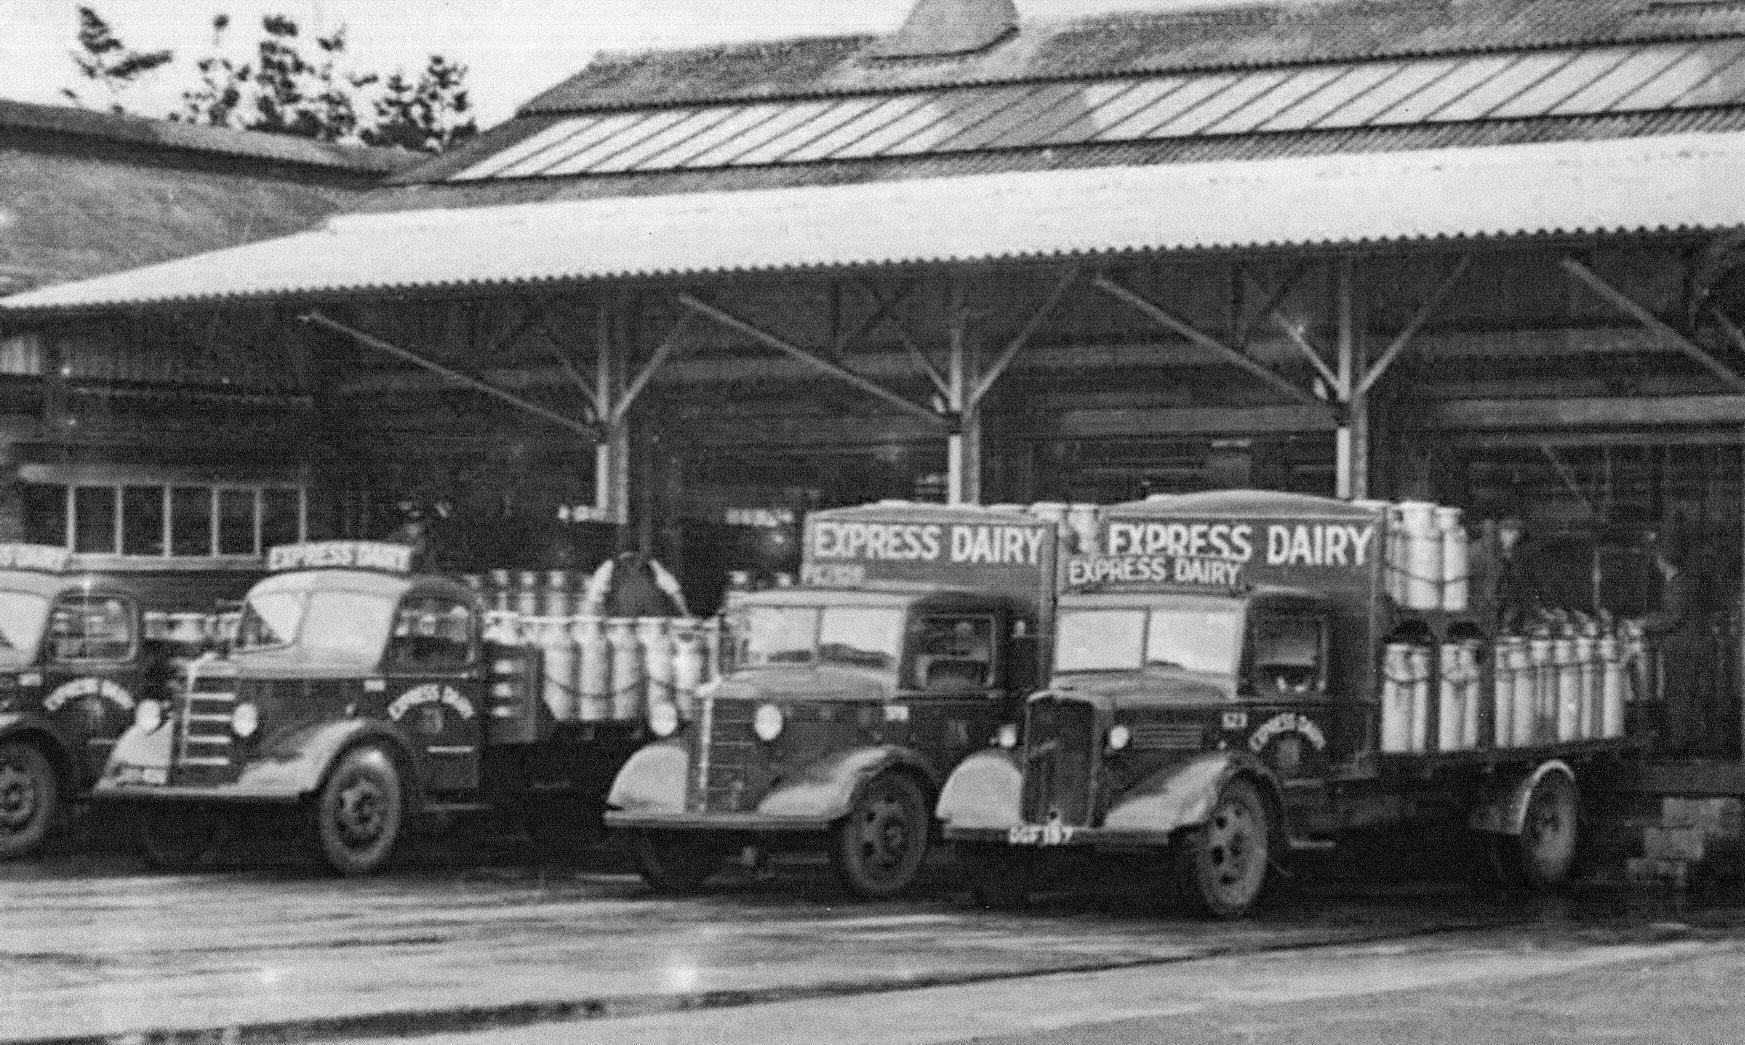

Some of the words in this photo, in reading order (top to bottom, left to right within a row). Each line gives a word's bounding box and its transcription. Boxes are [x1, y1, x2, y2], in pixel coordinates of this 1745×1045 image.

[814, 522, 943, 560] EXPRESS
[951, 526, 1045, 566] DAIRY
[1108, 523, 1253, 562] EXPRESS
[1267, 524, 1373, 566] DAIRY
[1069, 555, 1167, 585] EXPRESS
[1174, 557, 1240, 585] DAIRY
